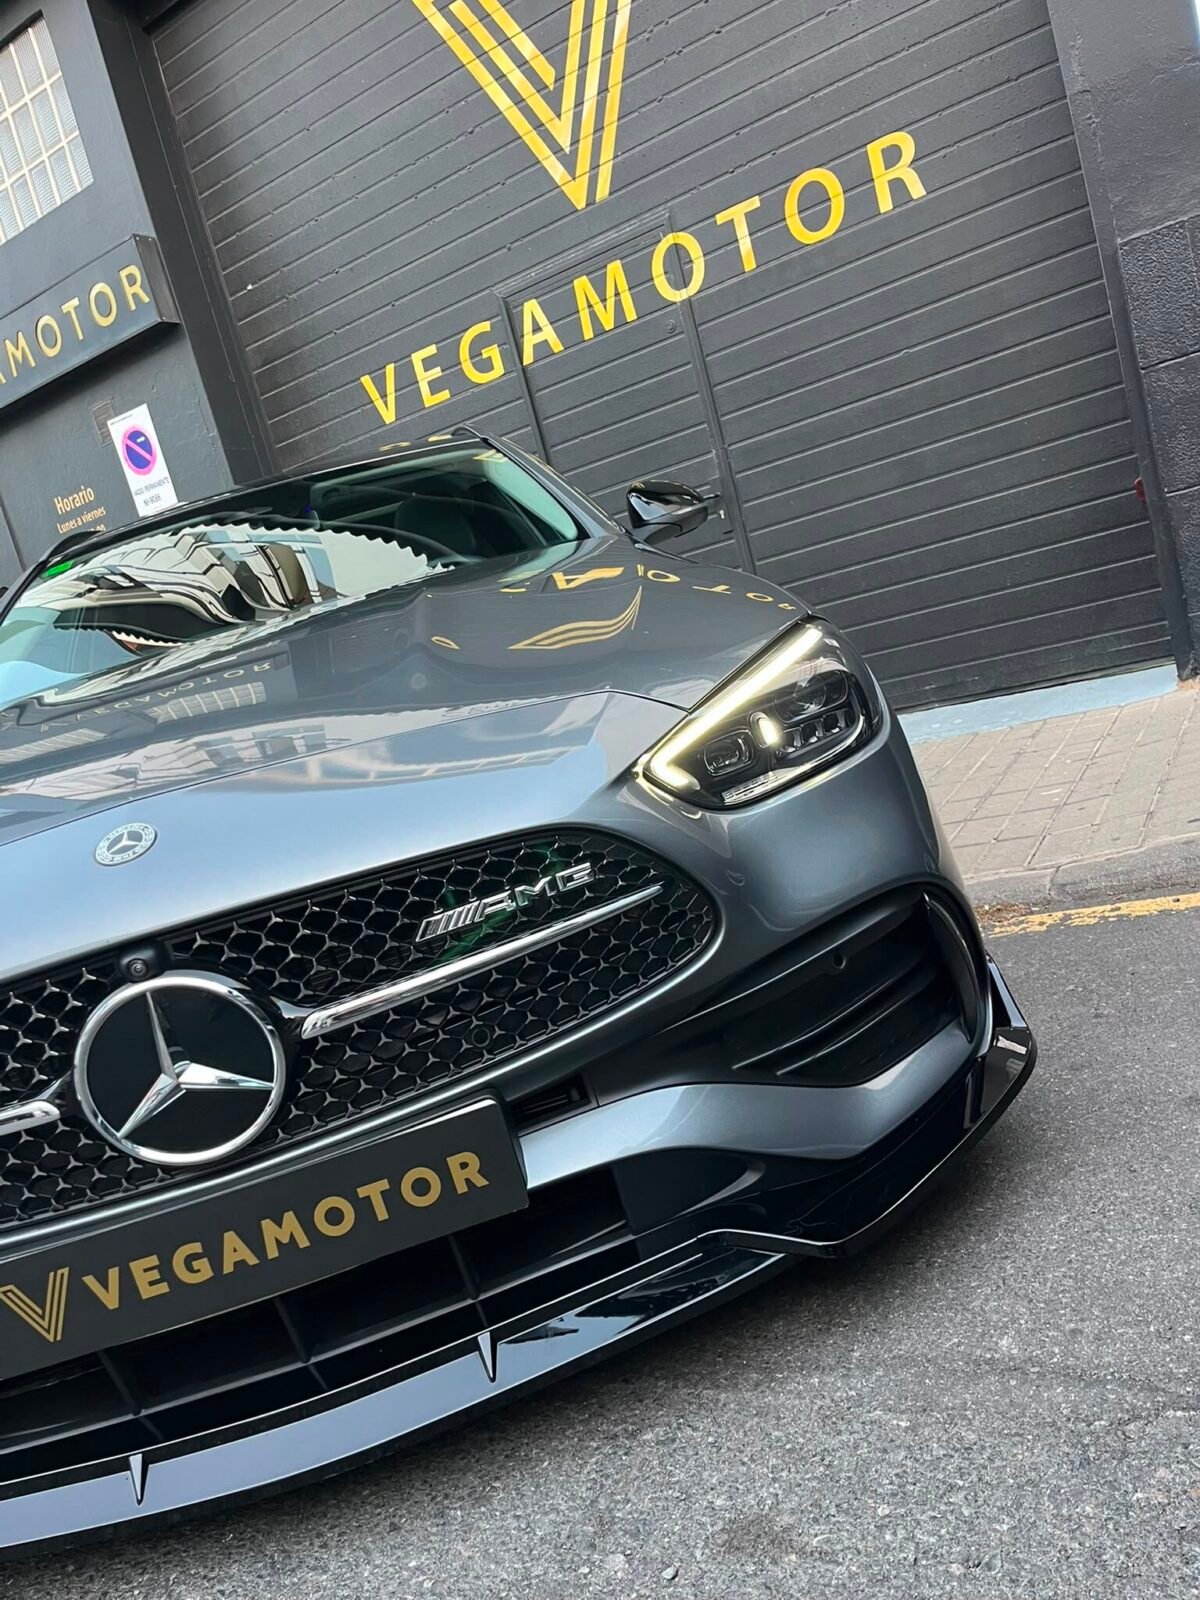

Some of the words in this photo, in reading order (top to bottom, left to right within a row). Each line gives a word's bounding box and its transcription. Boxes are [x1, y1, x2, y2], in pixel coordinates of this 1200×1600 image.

[360, 131, 927, 424] VEGAMOTOR
[0, 264, 150, 384] MOTOR
[54, 485, 95, 515] Horario
[57, 519, 77, 534] Lunes
[81, 506, 106, 524] viernes
[474, 862, 595, 923] AMG
[82, 1151, 489, 1311] VEGAMOTOR
